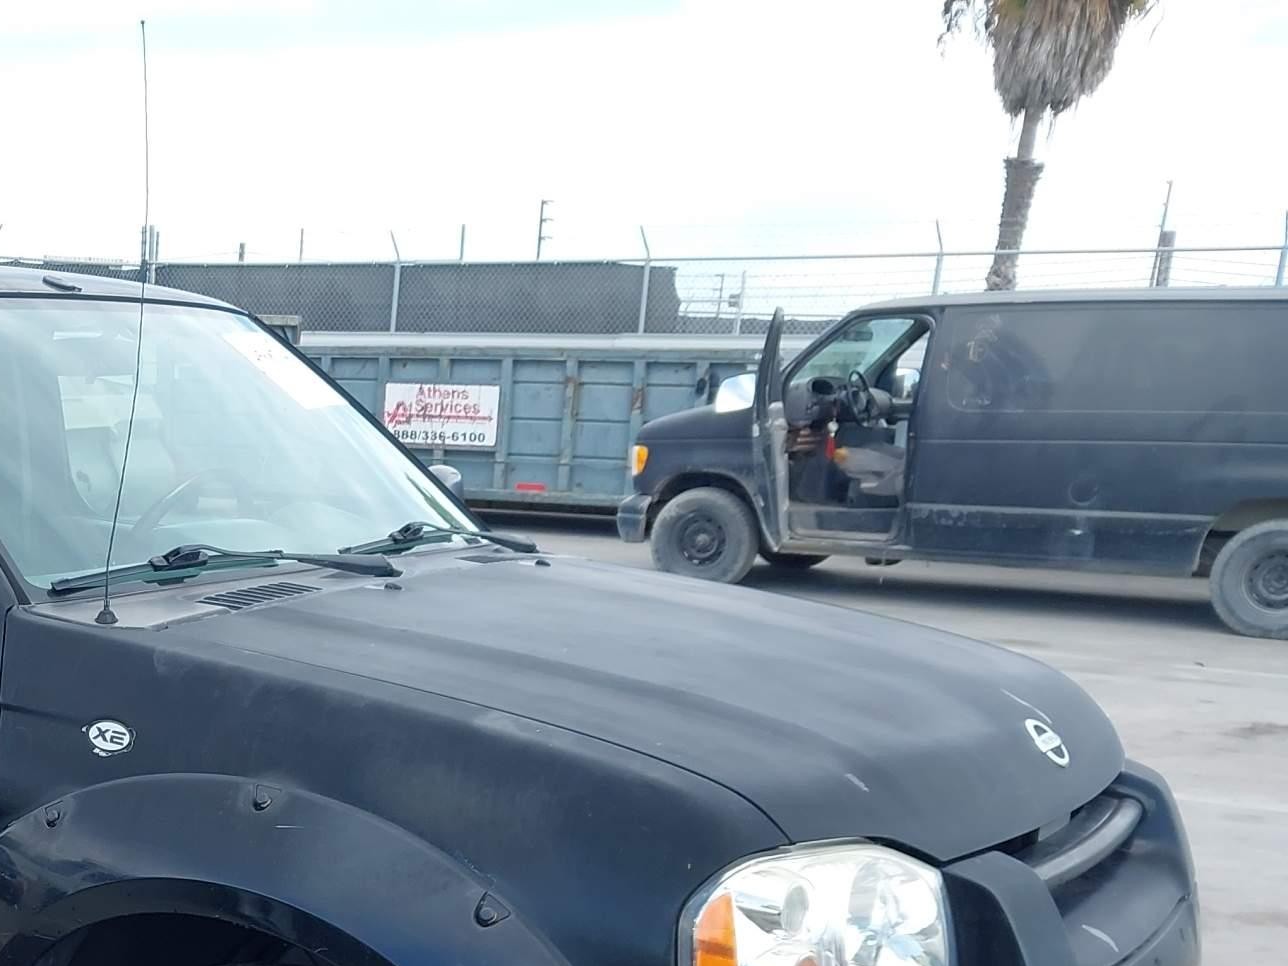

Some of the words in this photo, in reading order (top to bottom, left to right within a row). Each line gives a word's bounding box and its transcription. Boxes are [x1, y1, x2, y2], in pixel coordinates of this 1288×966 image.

[416, 385, 470, 400] Athens
[415, 399, 481, 415] Services
[92, 726, 127, 746] XE
